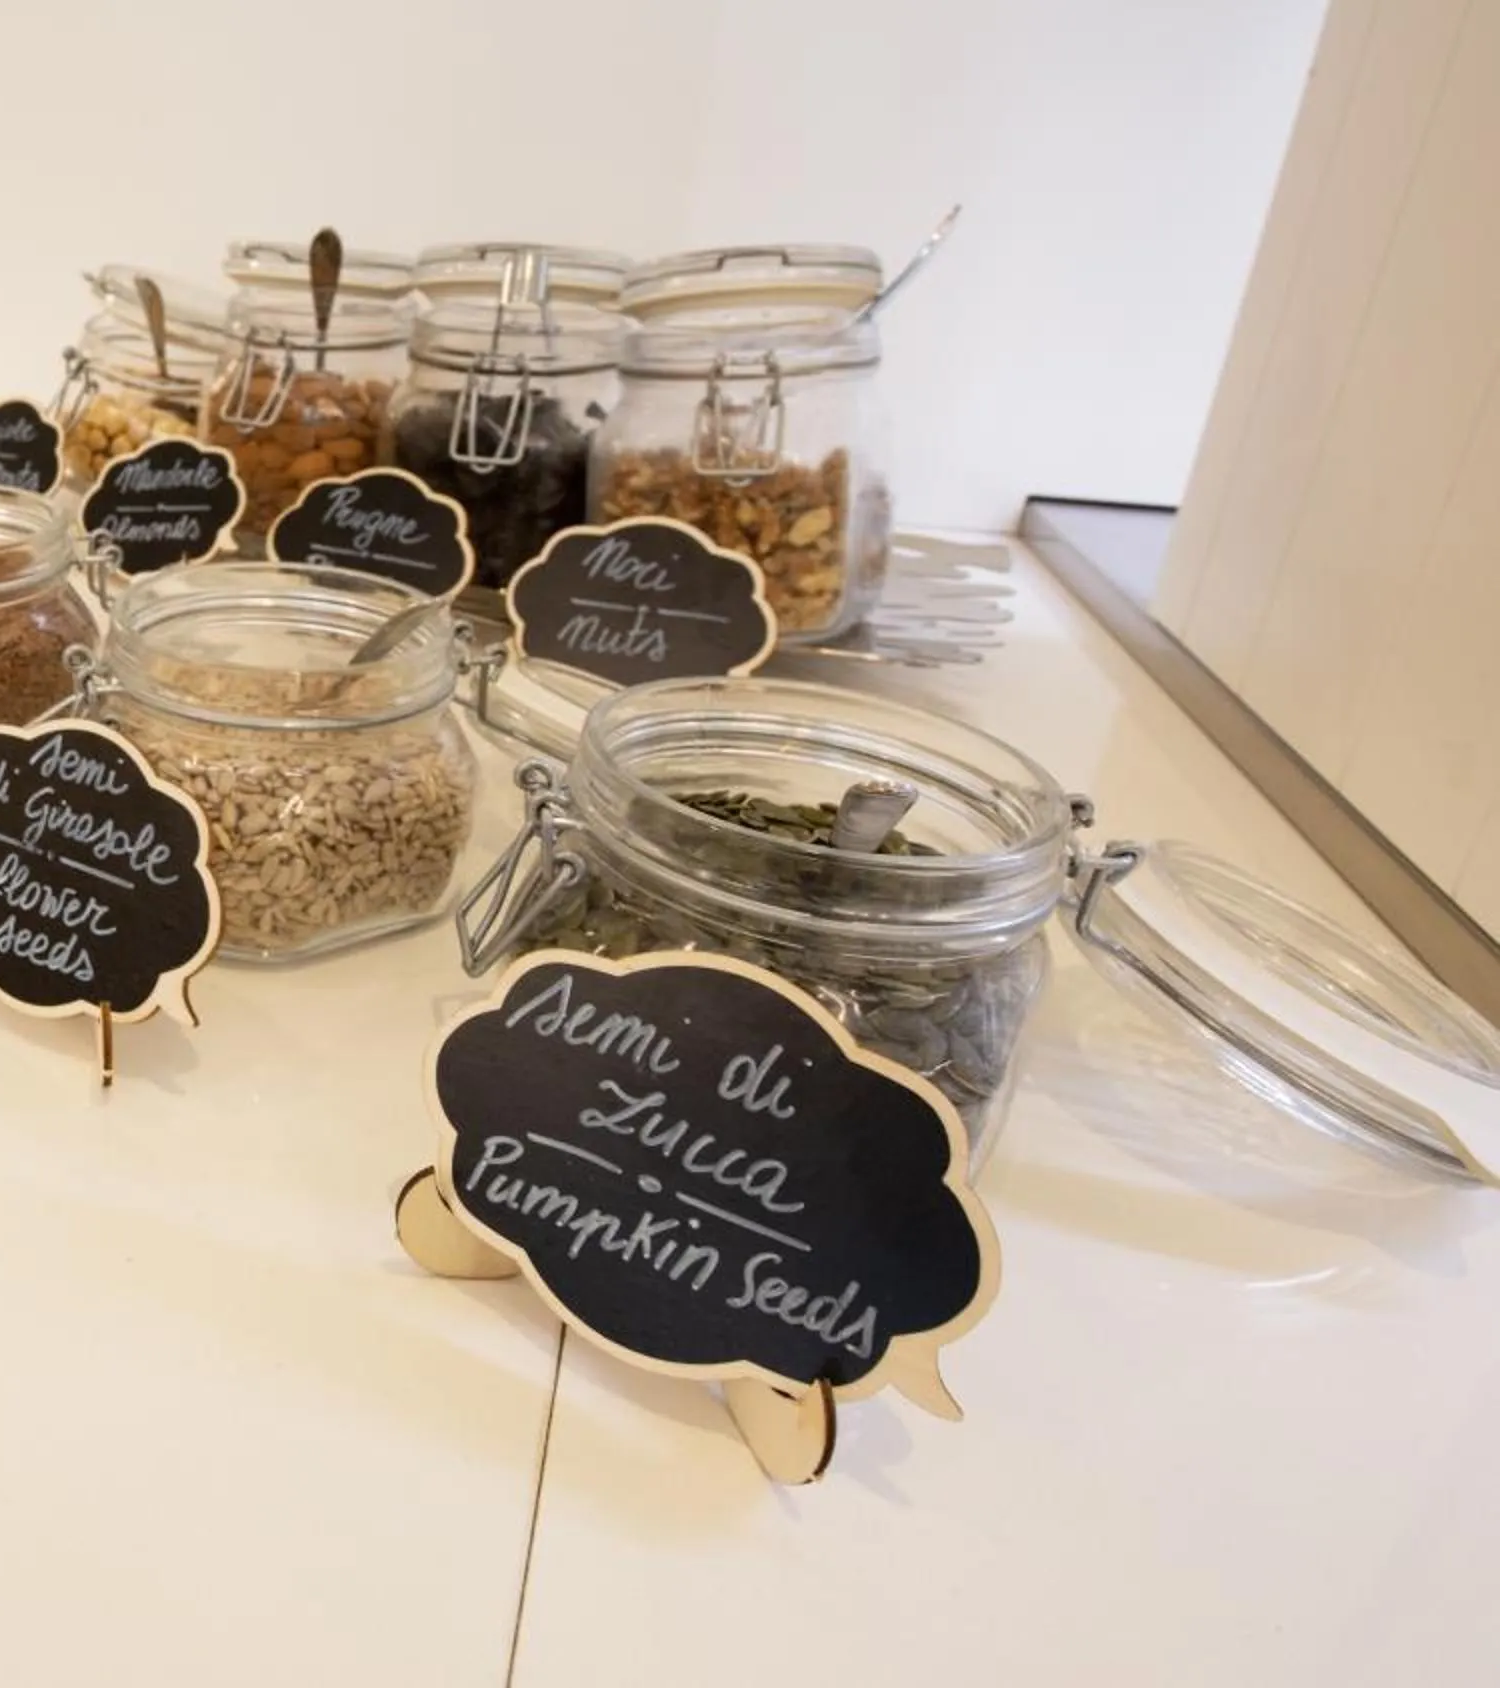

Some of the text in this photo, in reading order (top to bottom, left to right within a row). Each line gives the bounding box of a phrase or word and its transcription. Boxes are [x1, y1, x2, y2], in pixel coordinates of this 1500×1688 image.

[23, 786, 179, 885] Girasole
[717, 1044, 813, 1119] di
[578, 1079, 805, 1213] Zucca
